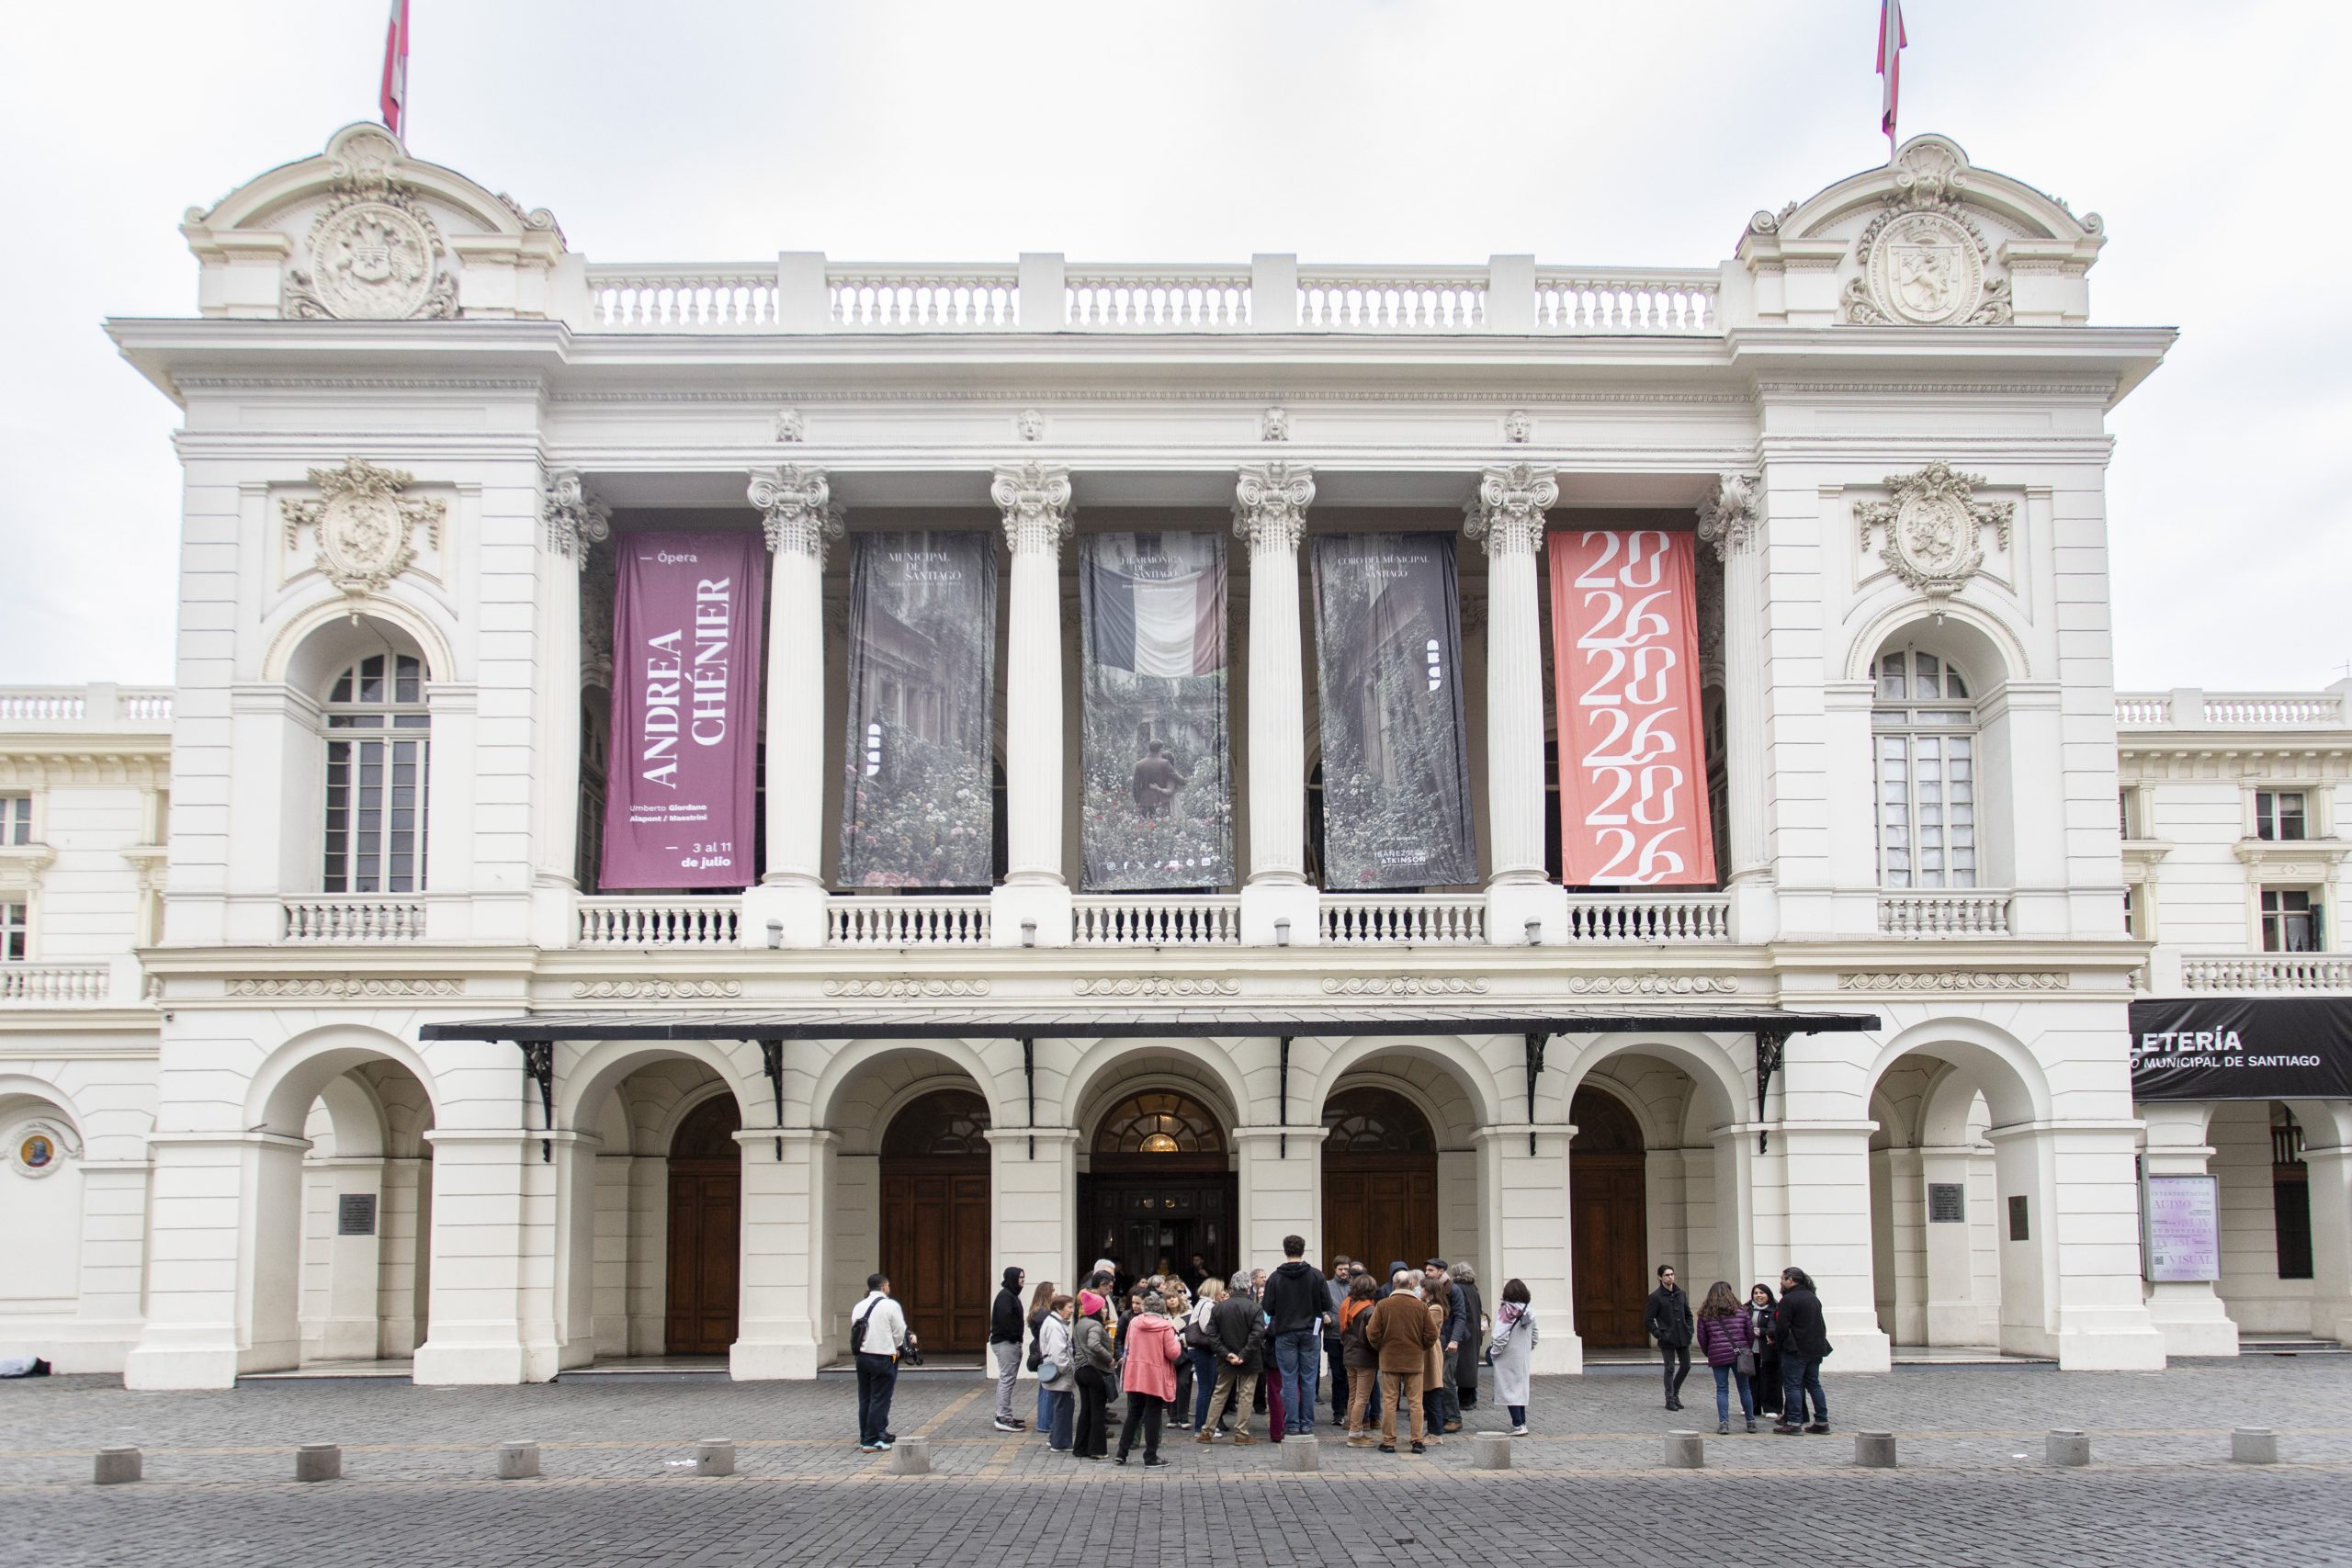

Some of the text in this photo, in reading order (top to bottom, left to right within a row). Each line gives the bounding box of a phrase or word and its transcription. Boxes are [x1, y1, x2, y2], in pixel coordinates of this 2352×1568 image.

[657, 550, 697, 563] Ópera
[888, 552, 950, 561] MUNICIPAL
[1338, 555, 1430, 565] CORO DEL MUNICIPAL
[1574, 531, 1670, 588] 20
[906, 562, 921, 571] DE
[905, 571, 961, 581] SANTIAGO
[1134, 570, 1177, 579] SANTIAGO
[1365, 570, 1408, 578] SANTIAGO
[1577, 590, 1672, 649] 26
[684, 576, 730, 747] CHÉNIER
[1578, 646, 1676, 705] 20
[643, 628, 683, 790] ANDREA
[1581, 706, 1679, 767] 26
[1585, 764, 1683, 825] 20
[629, 815, 662, 823] Alapont
[669, 814, 707, 822] Maestrini
[693, 841, 731, 852] 3 al 11
[681, 856, 731, 870] de julio
[1589, 827, 1686, 886] 26
[2143, 1056, 2221, 1068] MUNICIPAL
[2224, 1056, 2245, 1067] DE
[2247, 1055, 2321, 1067] SANTIAGO
